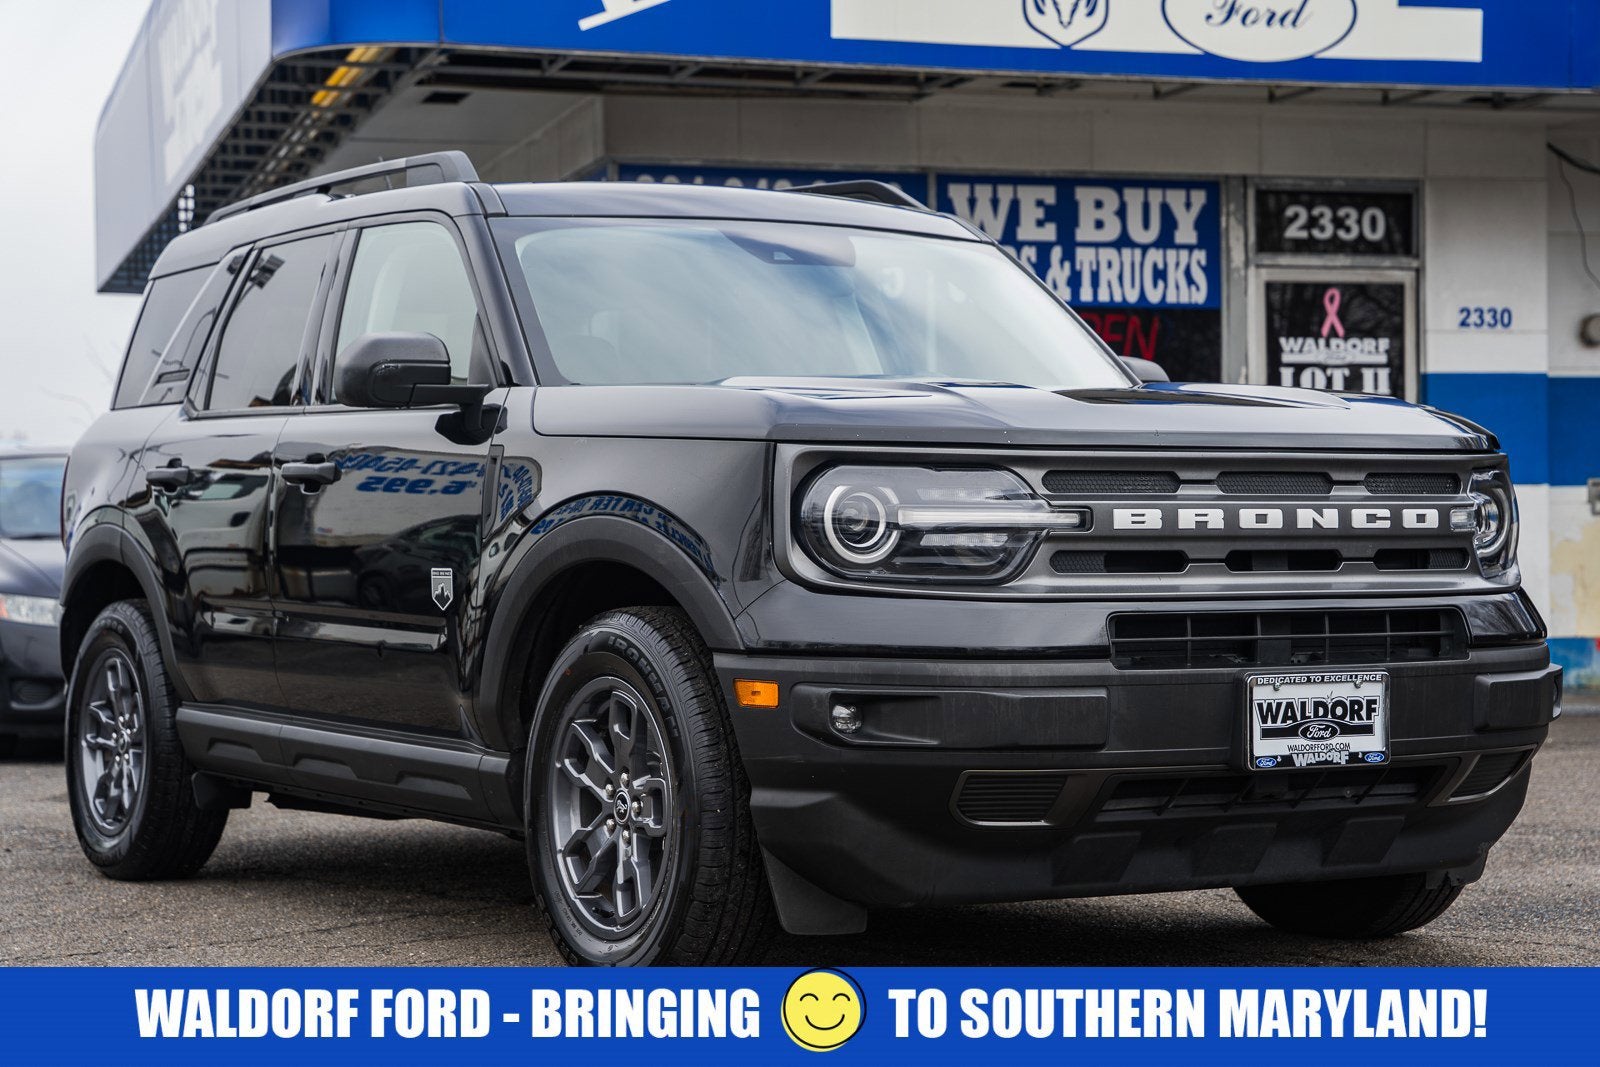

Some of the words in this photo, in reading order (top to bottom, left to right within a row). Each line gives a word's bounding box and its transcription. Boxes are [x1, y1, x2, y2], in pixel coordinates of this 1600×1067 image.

[947, 183, 1057, 242] WE
[1075, 186, 1206, 245] BUY
[1284, 205, 1386, 243] 2330
[1045, 246, 1071, 302] &
[1075, 247, 1208, 305] TRUCKS
[1459, 307, 1513, 329] 2330
[1279, 337, 1390, 354] WALDORF
[1113, 508, 1440, 530] BRONCO
[1257, 676, 1307, 685] DEDICATED
[1310, 675, 1322, 683] TO
[1323, 674, 1382, 682] EXCELLENCE
[1254, 697, 1380, 725] WALDORF
[1306, 725, 1332, 738] Ford
[1292, 750, 1349, 767] WALDORF
